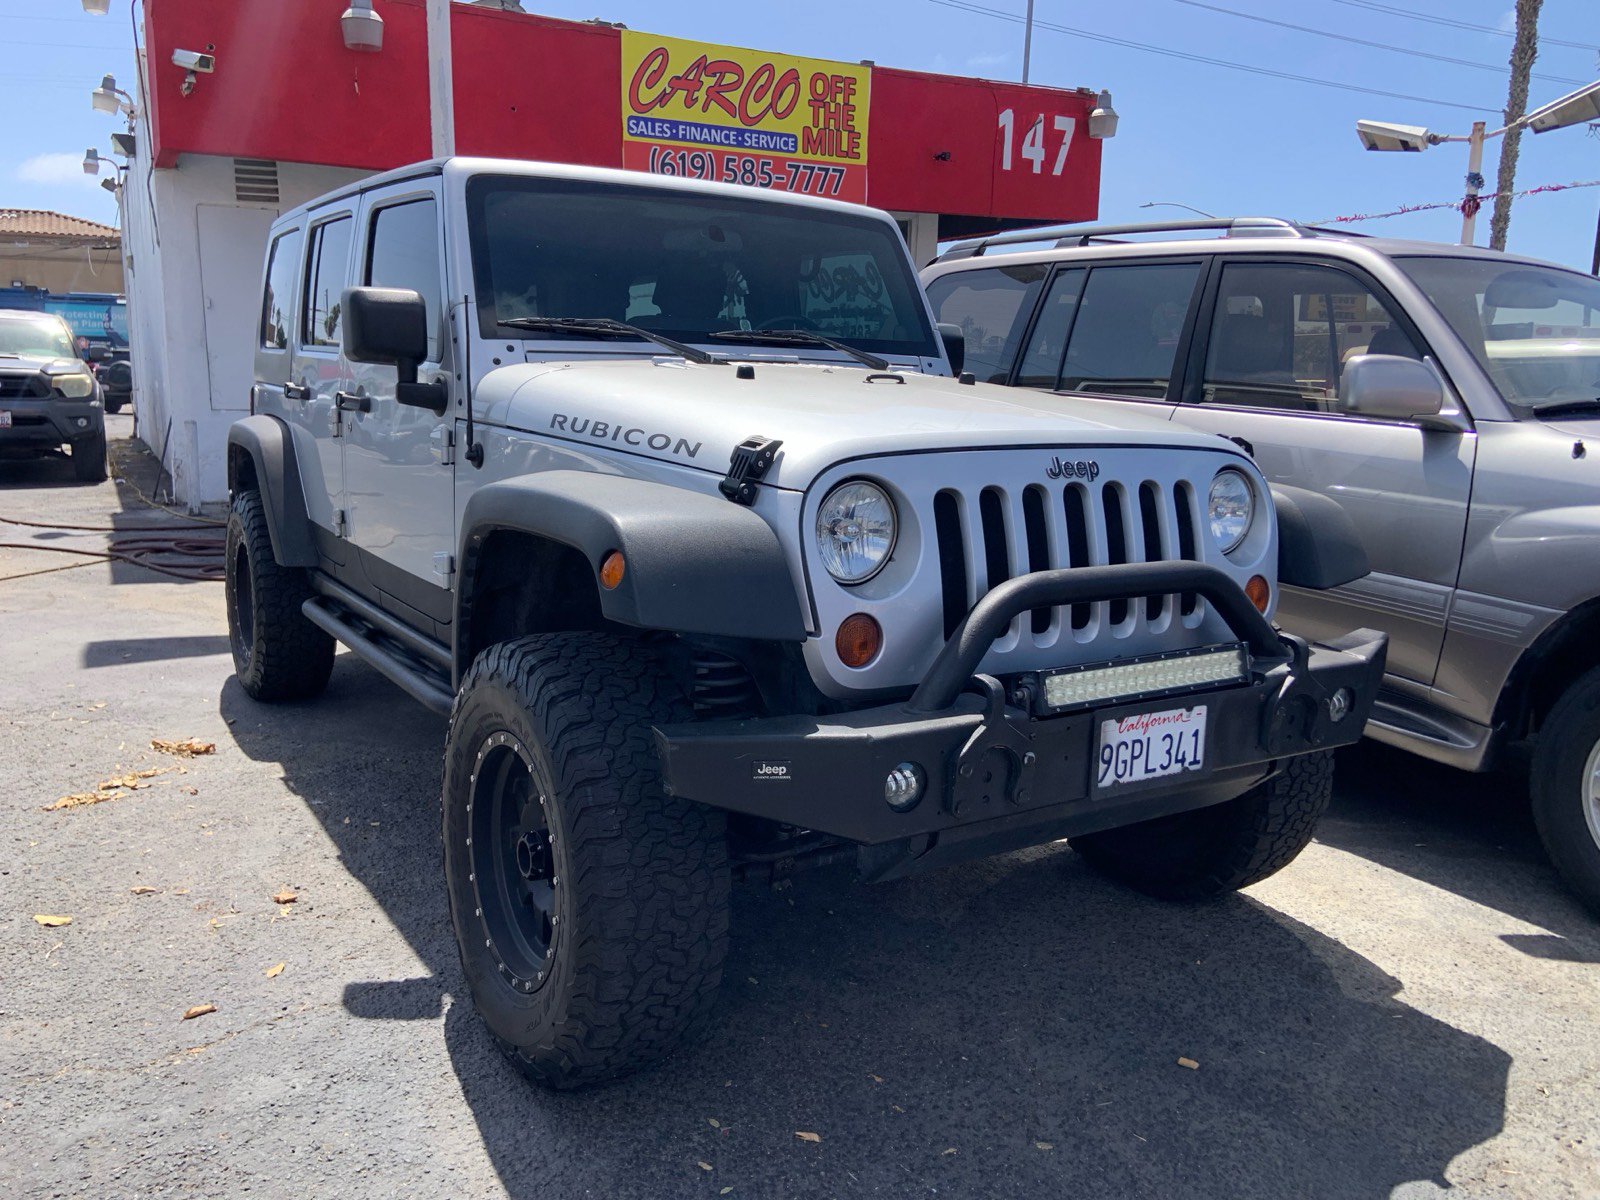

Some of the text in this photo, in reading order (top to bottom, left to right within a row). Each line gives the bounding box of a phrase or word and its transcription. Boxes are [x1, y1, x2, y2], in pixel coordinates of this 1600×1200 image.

[628, 47, 800, 126] CARCO
[809, 72, 857, 103] OFF
[808, 99, 856, 132] THE
[628, 120, 796, 152] SALES FINANCE SERVICE
[802, 126, 861, 160] MILE
[998, 108, 1076, 176] 147
[649, 146, 847, 196] (619) 585-7777
[550, 413, 703, 459] RUBICON
[1046, 456, 1100, 482] Jeep
[1117, 711, 1191, 735] California
[757, 763, 787, 776] Jeep
[1098, 728, 1201, 784] 9GPL341
